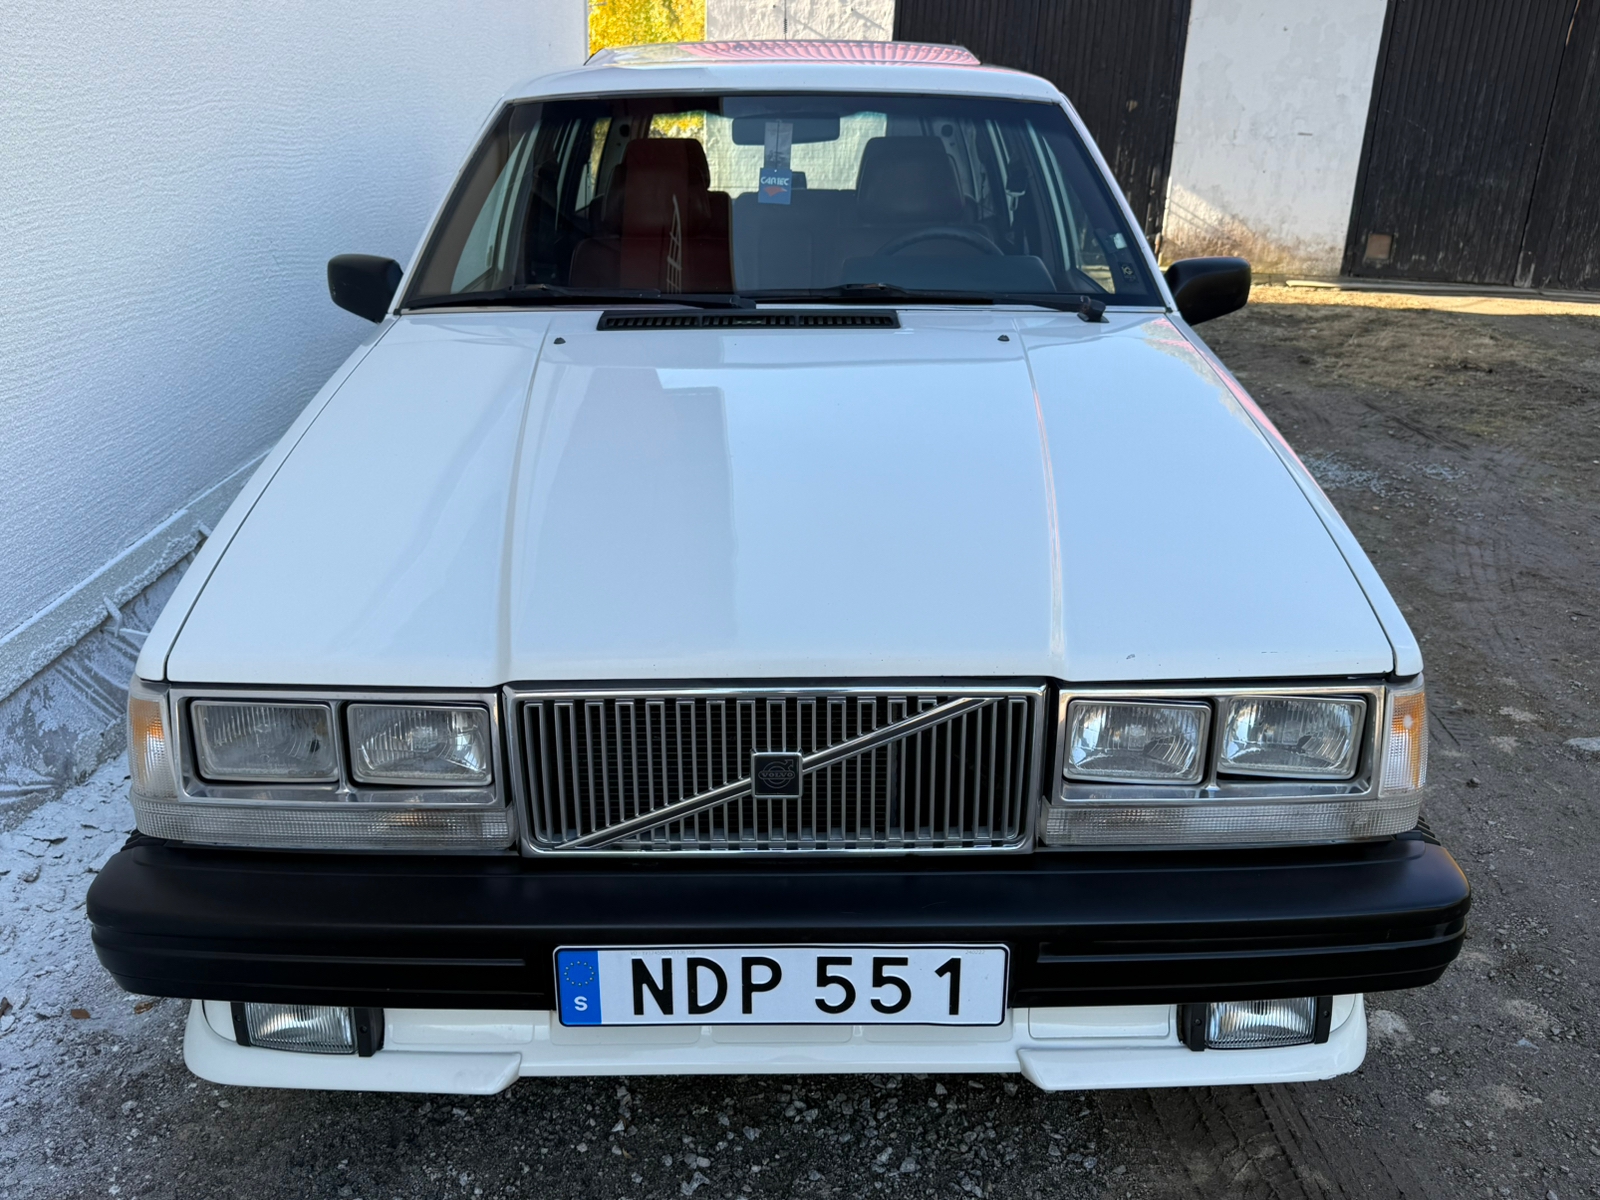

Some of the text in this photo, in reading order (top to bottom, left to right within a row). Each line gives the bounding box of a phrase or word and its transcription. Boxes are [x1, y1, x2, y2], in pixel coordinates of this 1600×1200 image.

[574, 996, 588, 1011] S
[631, 956, 962, 1016] NDP 551
